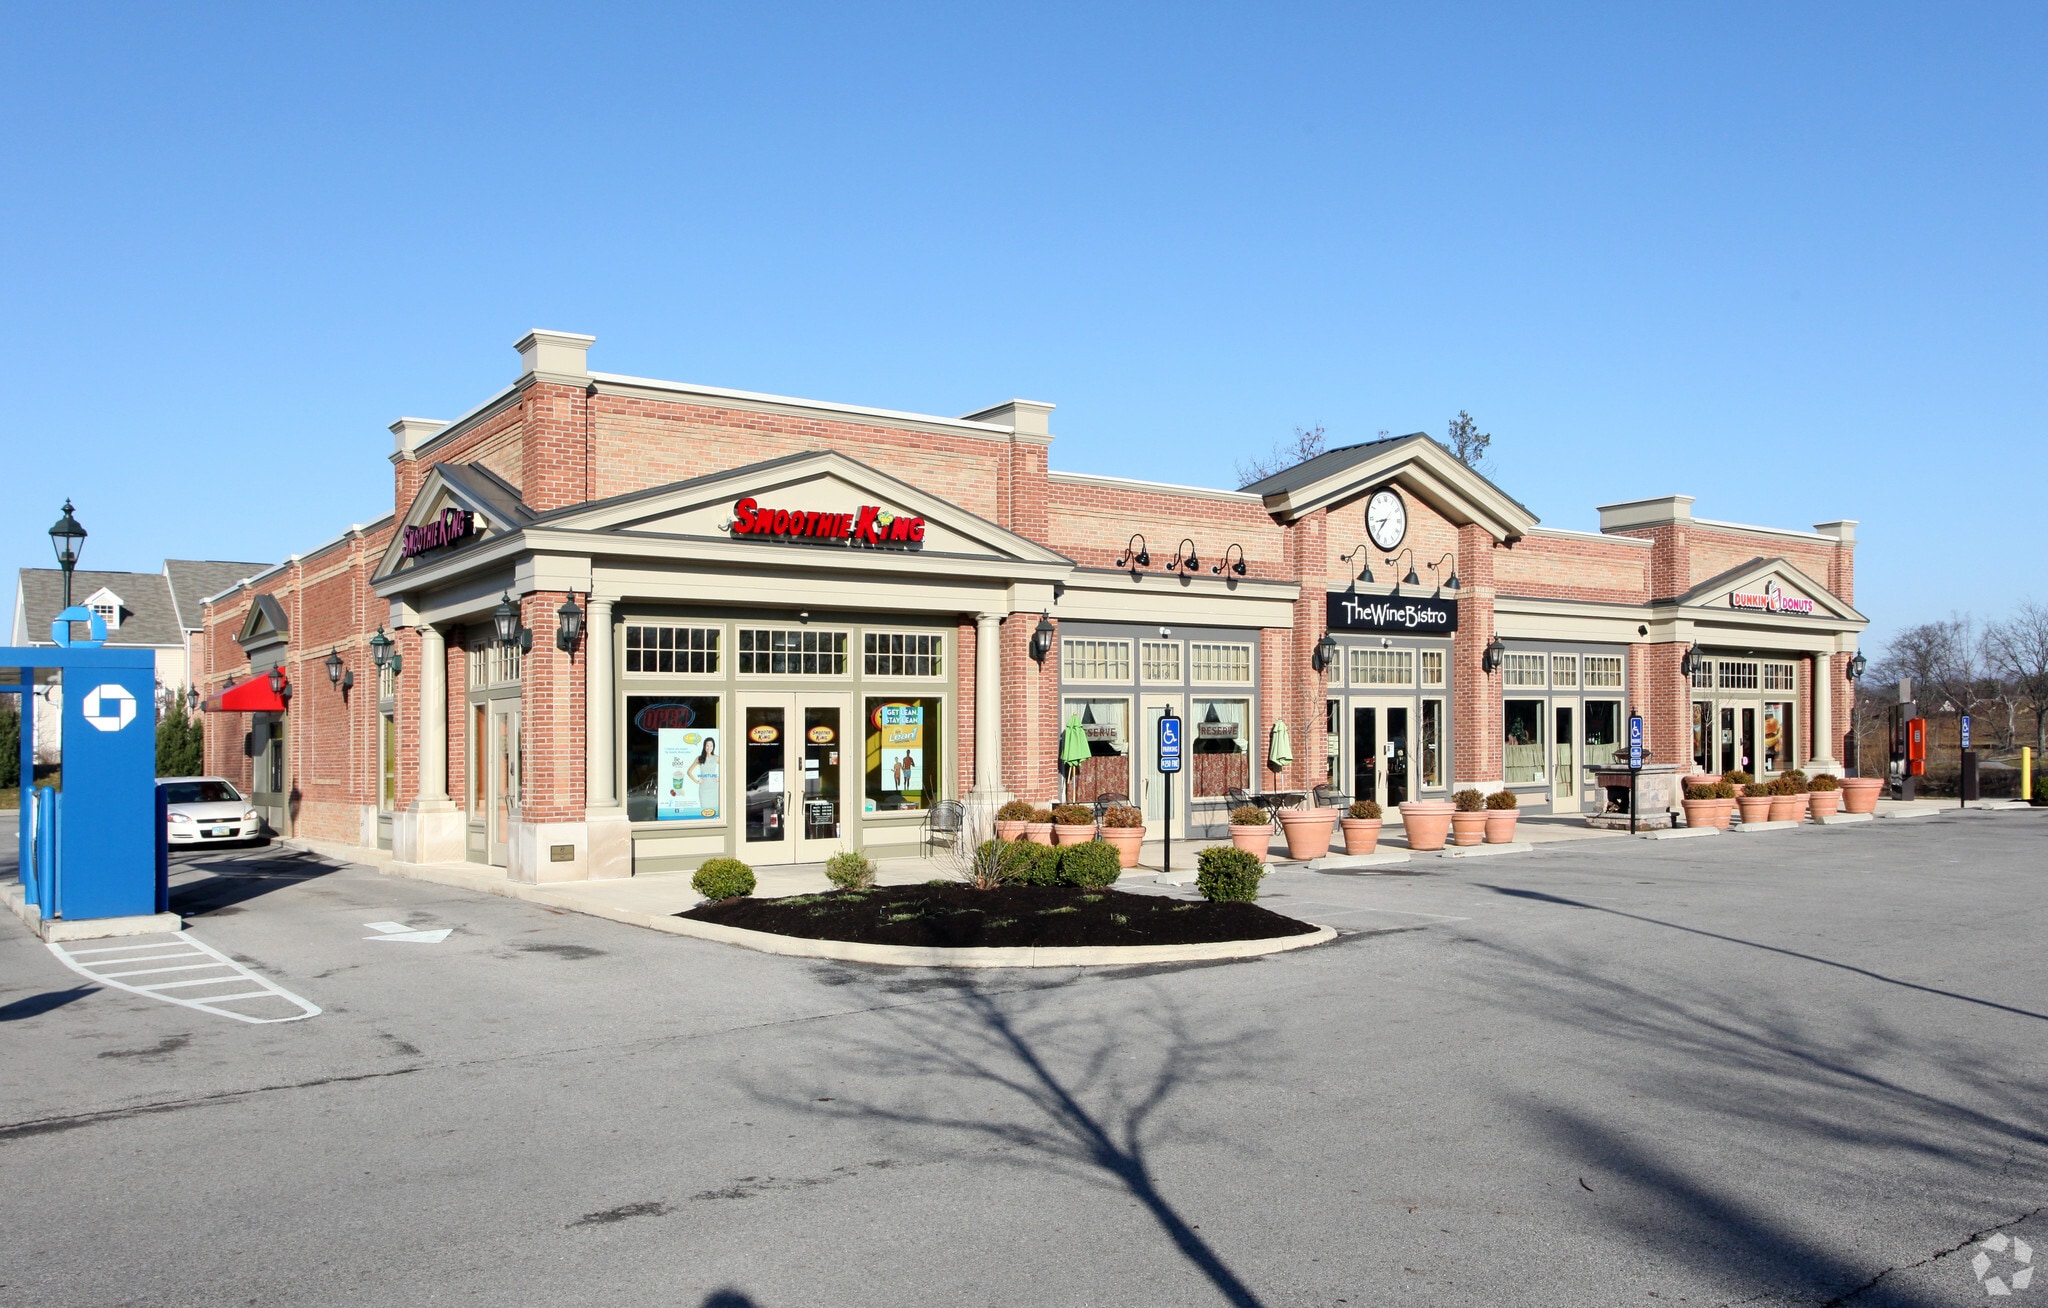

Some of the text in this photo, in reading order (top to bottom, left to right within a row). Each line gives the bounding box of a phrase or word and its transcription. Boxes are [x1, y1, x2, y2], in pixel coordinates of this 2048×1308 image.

[734, 497, 926, 545] SMOOTHIE KING
[403, 521, 439, 558] SMOOTHIE
[1782, 597, 1813, 612] DONUTS
[1083, 727, 1117, 738] SERVE
[1201, 724, 1239, 736] RESERVE
